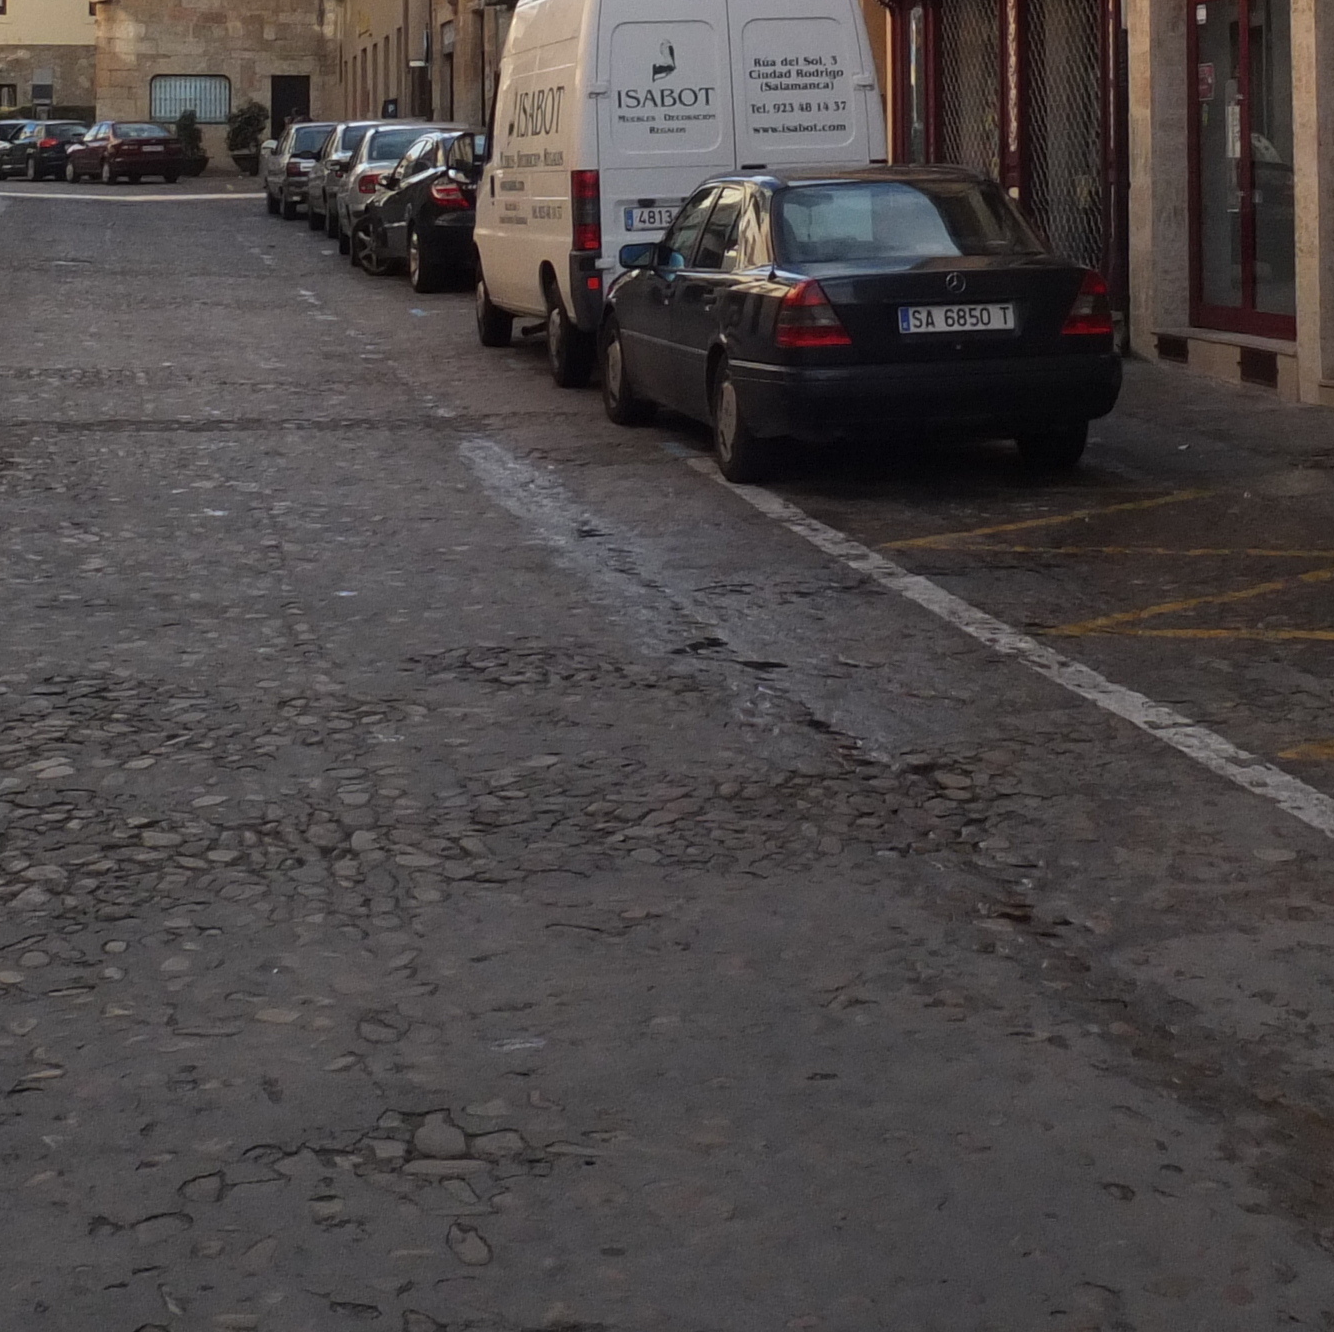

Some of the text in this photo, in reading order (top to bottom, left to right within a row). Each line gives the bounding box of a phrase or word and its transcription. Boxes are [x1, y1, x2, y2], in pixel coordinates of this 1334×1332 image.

[780, 57, 799, 66] del
[803, 56, 826, 67] Sol,
[749, 68, 844, 79] Ciudad Rodrigo
[760, 81, 834, 92] (Salamanca)
[618, 87, 715, 109] ISABOT
[516, 86, 565, 138] ISABOT
[752, 123, 847, 134] www.isabot.com
[639, 210, 673, 225] 4813
[912, 307, 1009, 329] SA 6850 T
